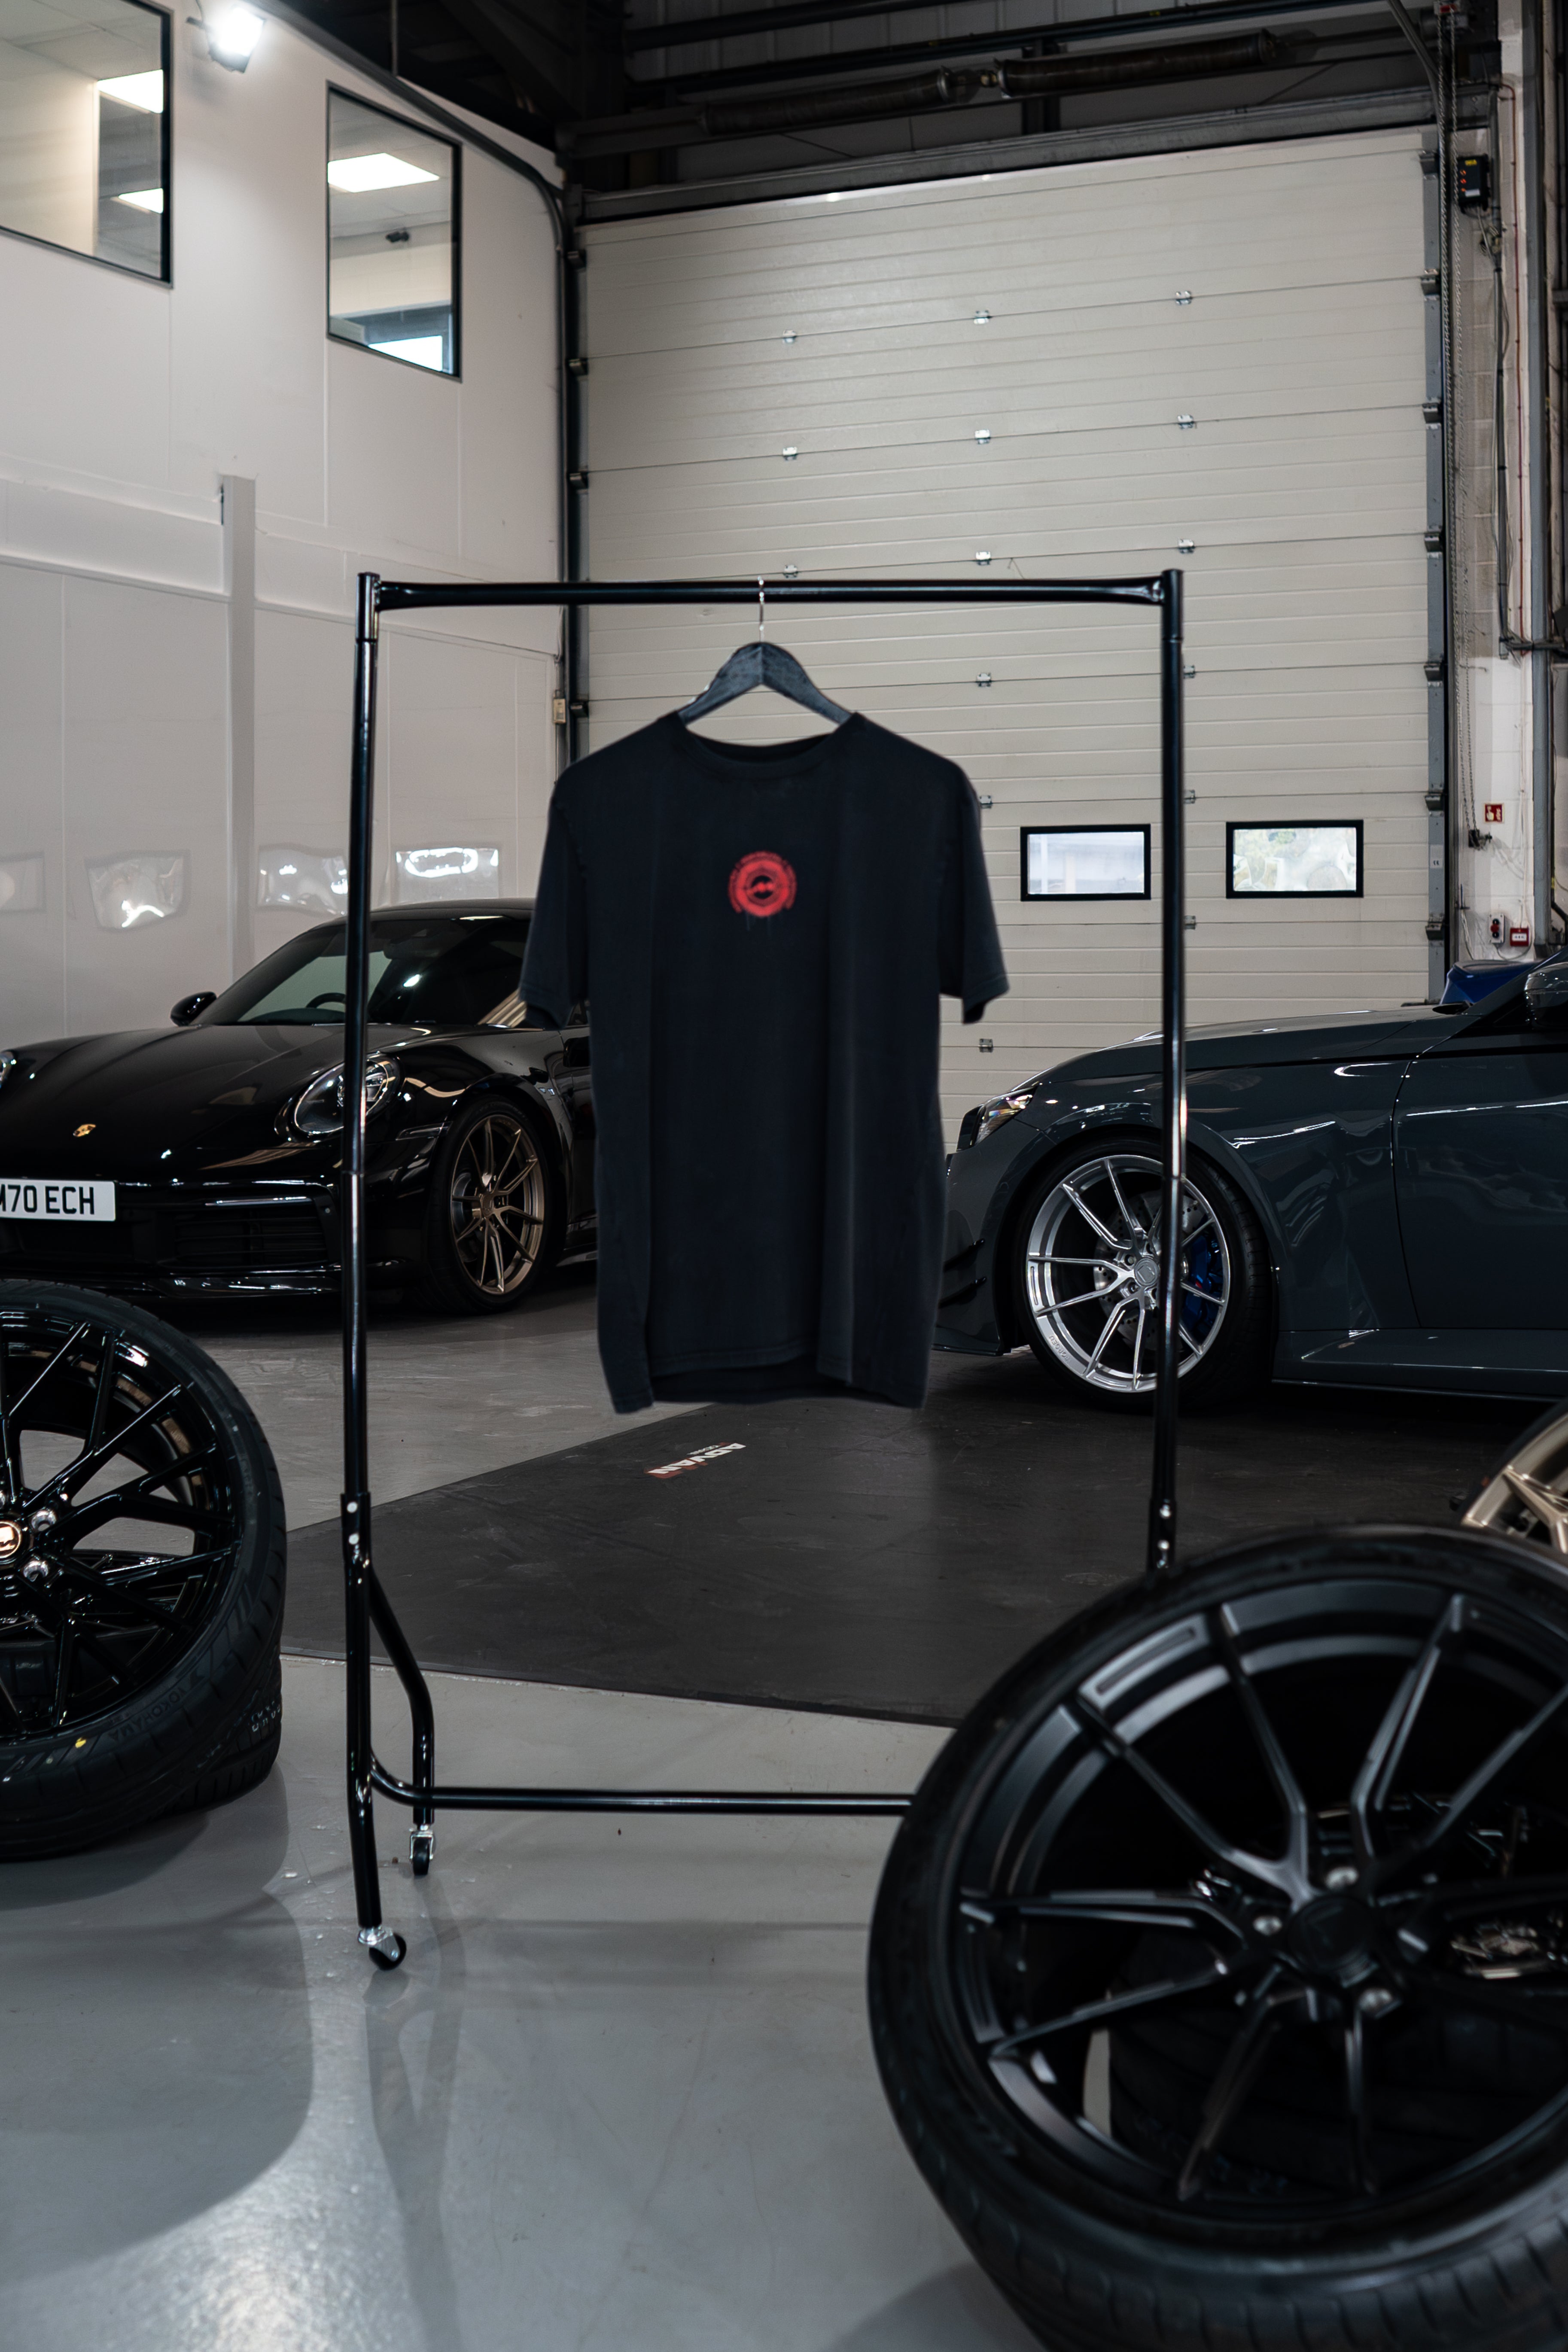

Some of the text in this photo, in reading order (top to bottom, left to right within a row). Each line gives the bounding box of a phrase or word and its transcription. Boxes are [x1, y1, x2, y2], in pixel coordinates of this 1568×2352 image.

[45, 1186, 94, 1214] ECH
[648, 1442, 746, 1474] ADVAN
[108, 1686, 187, 1741] YOKOHAMA
